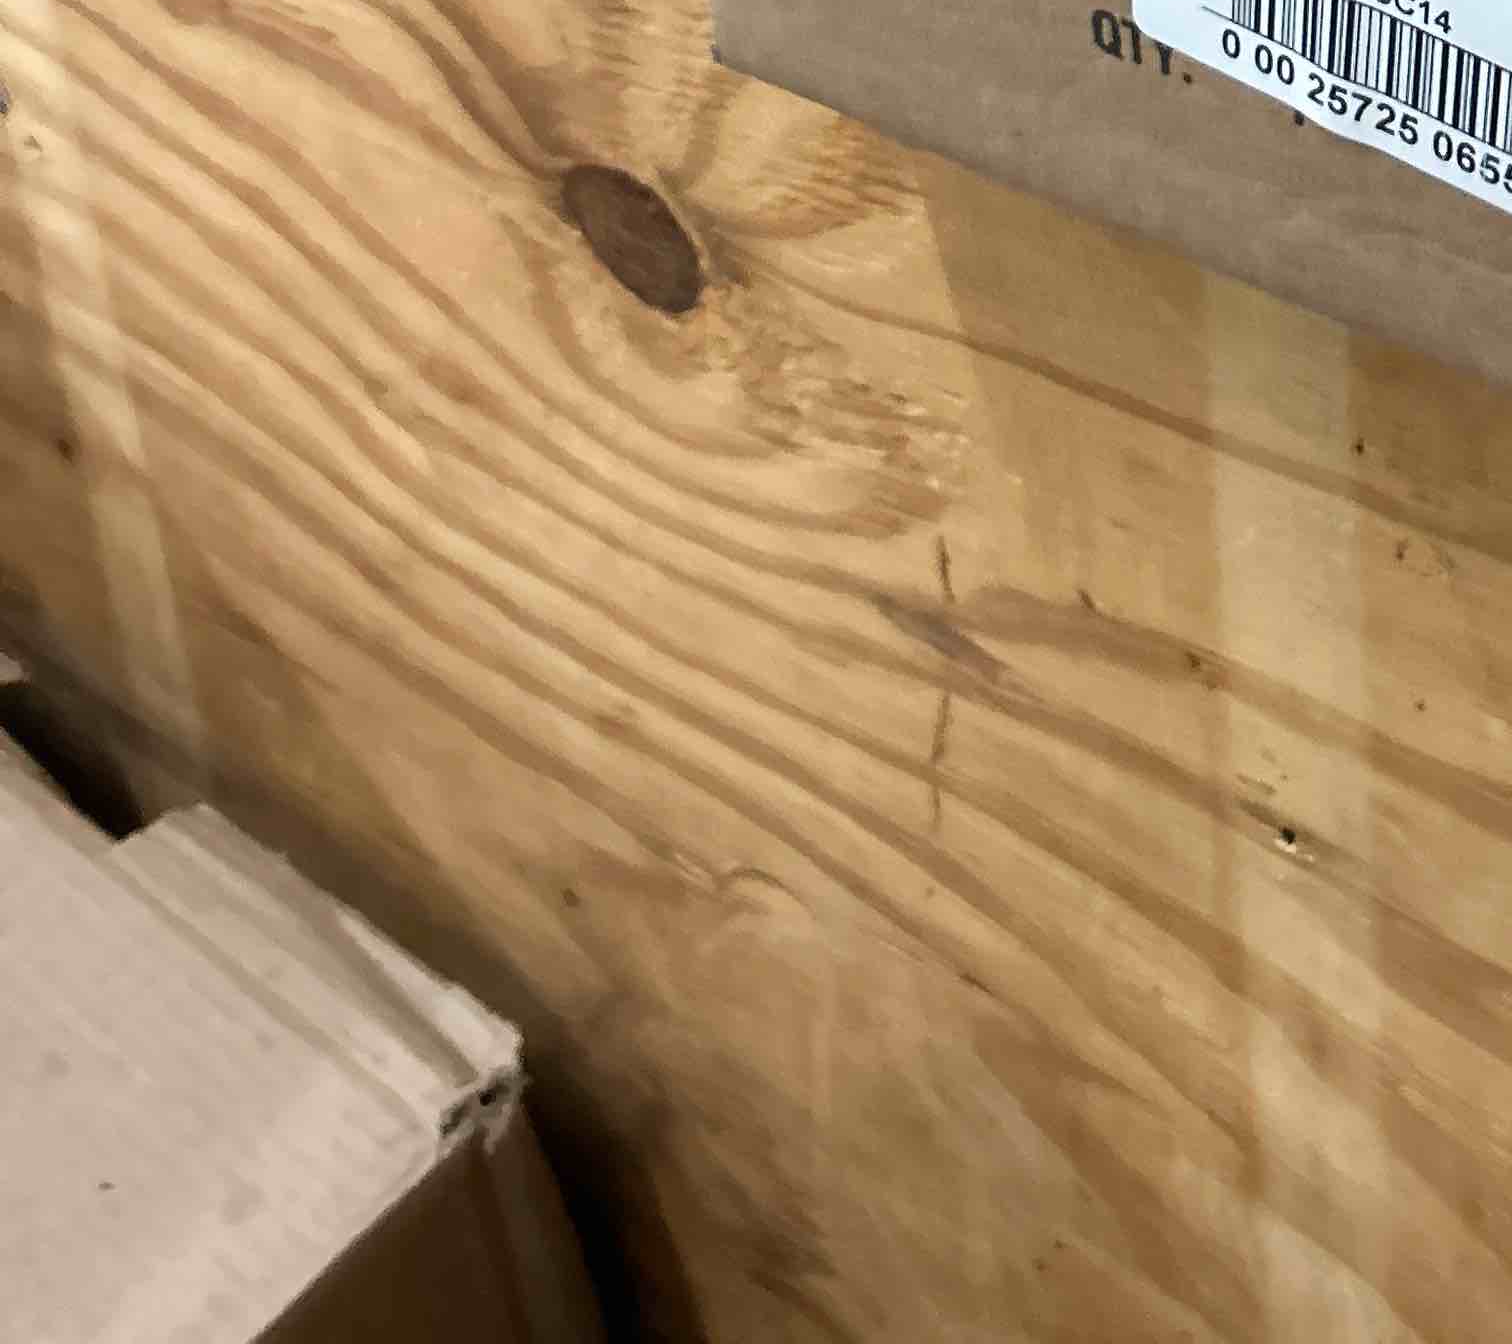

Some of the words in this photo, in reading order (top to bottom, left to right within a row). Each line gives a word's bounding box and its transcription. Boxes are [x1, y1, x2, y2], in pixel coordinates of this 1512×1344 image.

[1221, 28, 1241, 59] 0
[1254, 43, 1296, 85] 00
[1306, 71, 1420, 146] 25725
